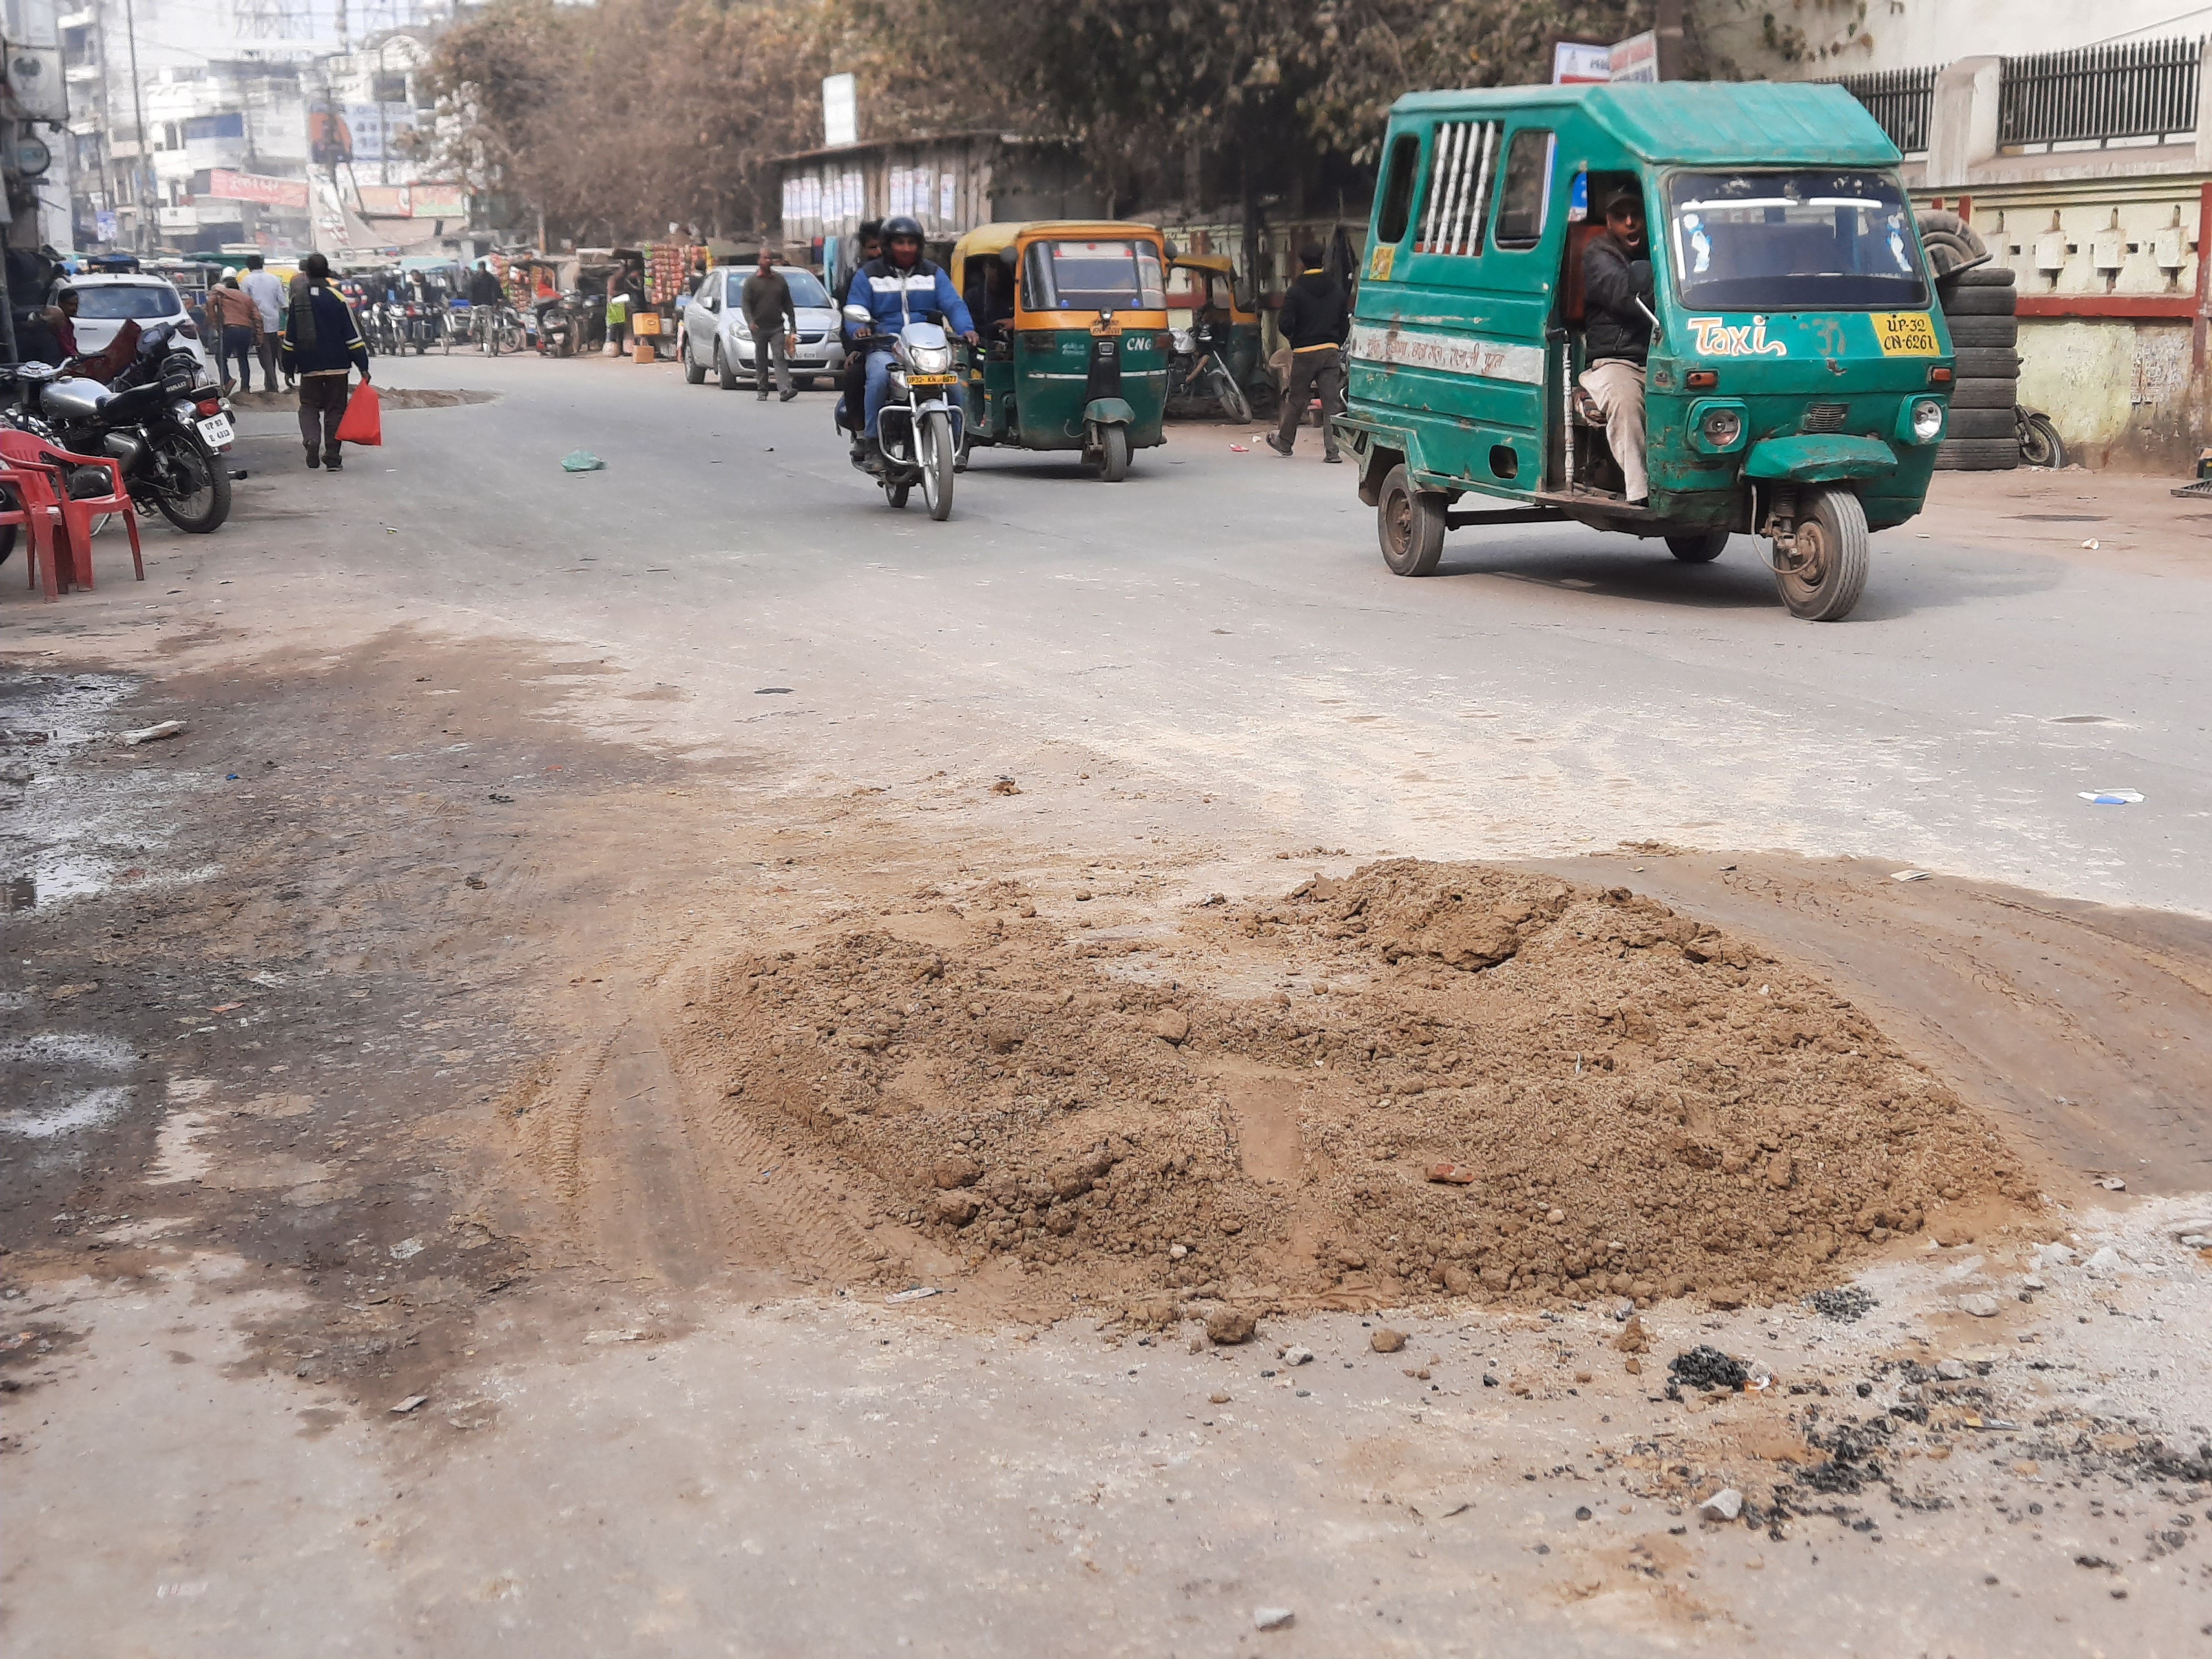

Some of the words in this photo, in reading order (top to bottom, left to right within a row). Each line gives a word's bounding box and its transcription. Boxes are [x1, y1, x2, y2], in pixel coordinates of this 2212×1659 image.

[1886, 318, 1927, 332] UP-32
[1688, 315, 1787, 357] Taxi
[1126, 337, 1152, 351] CNG
